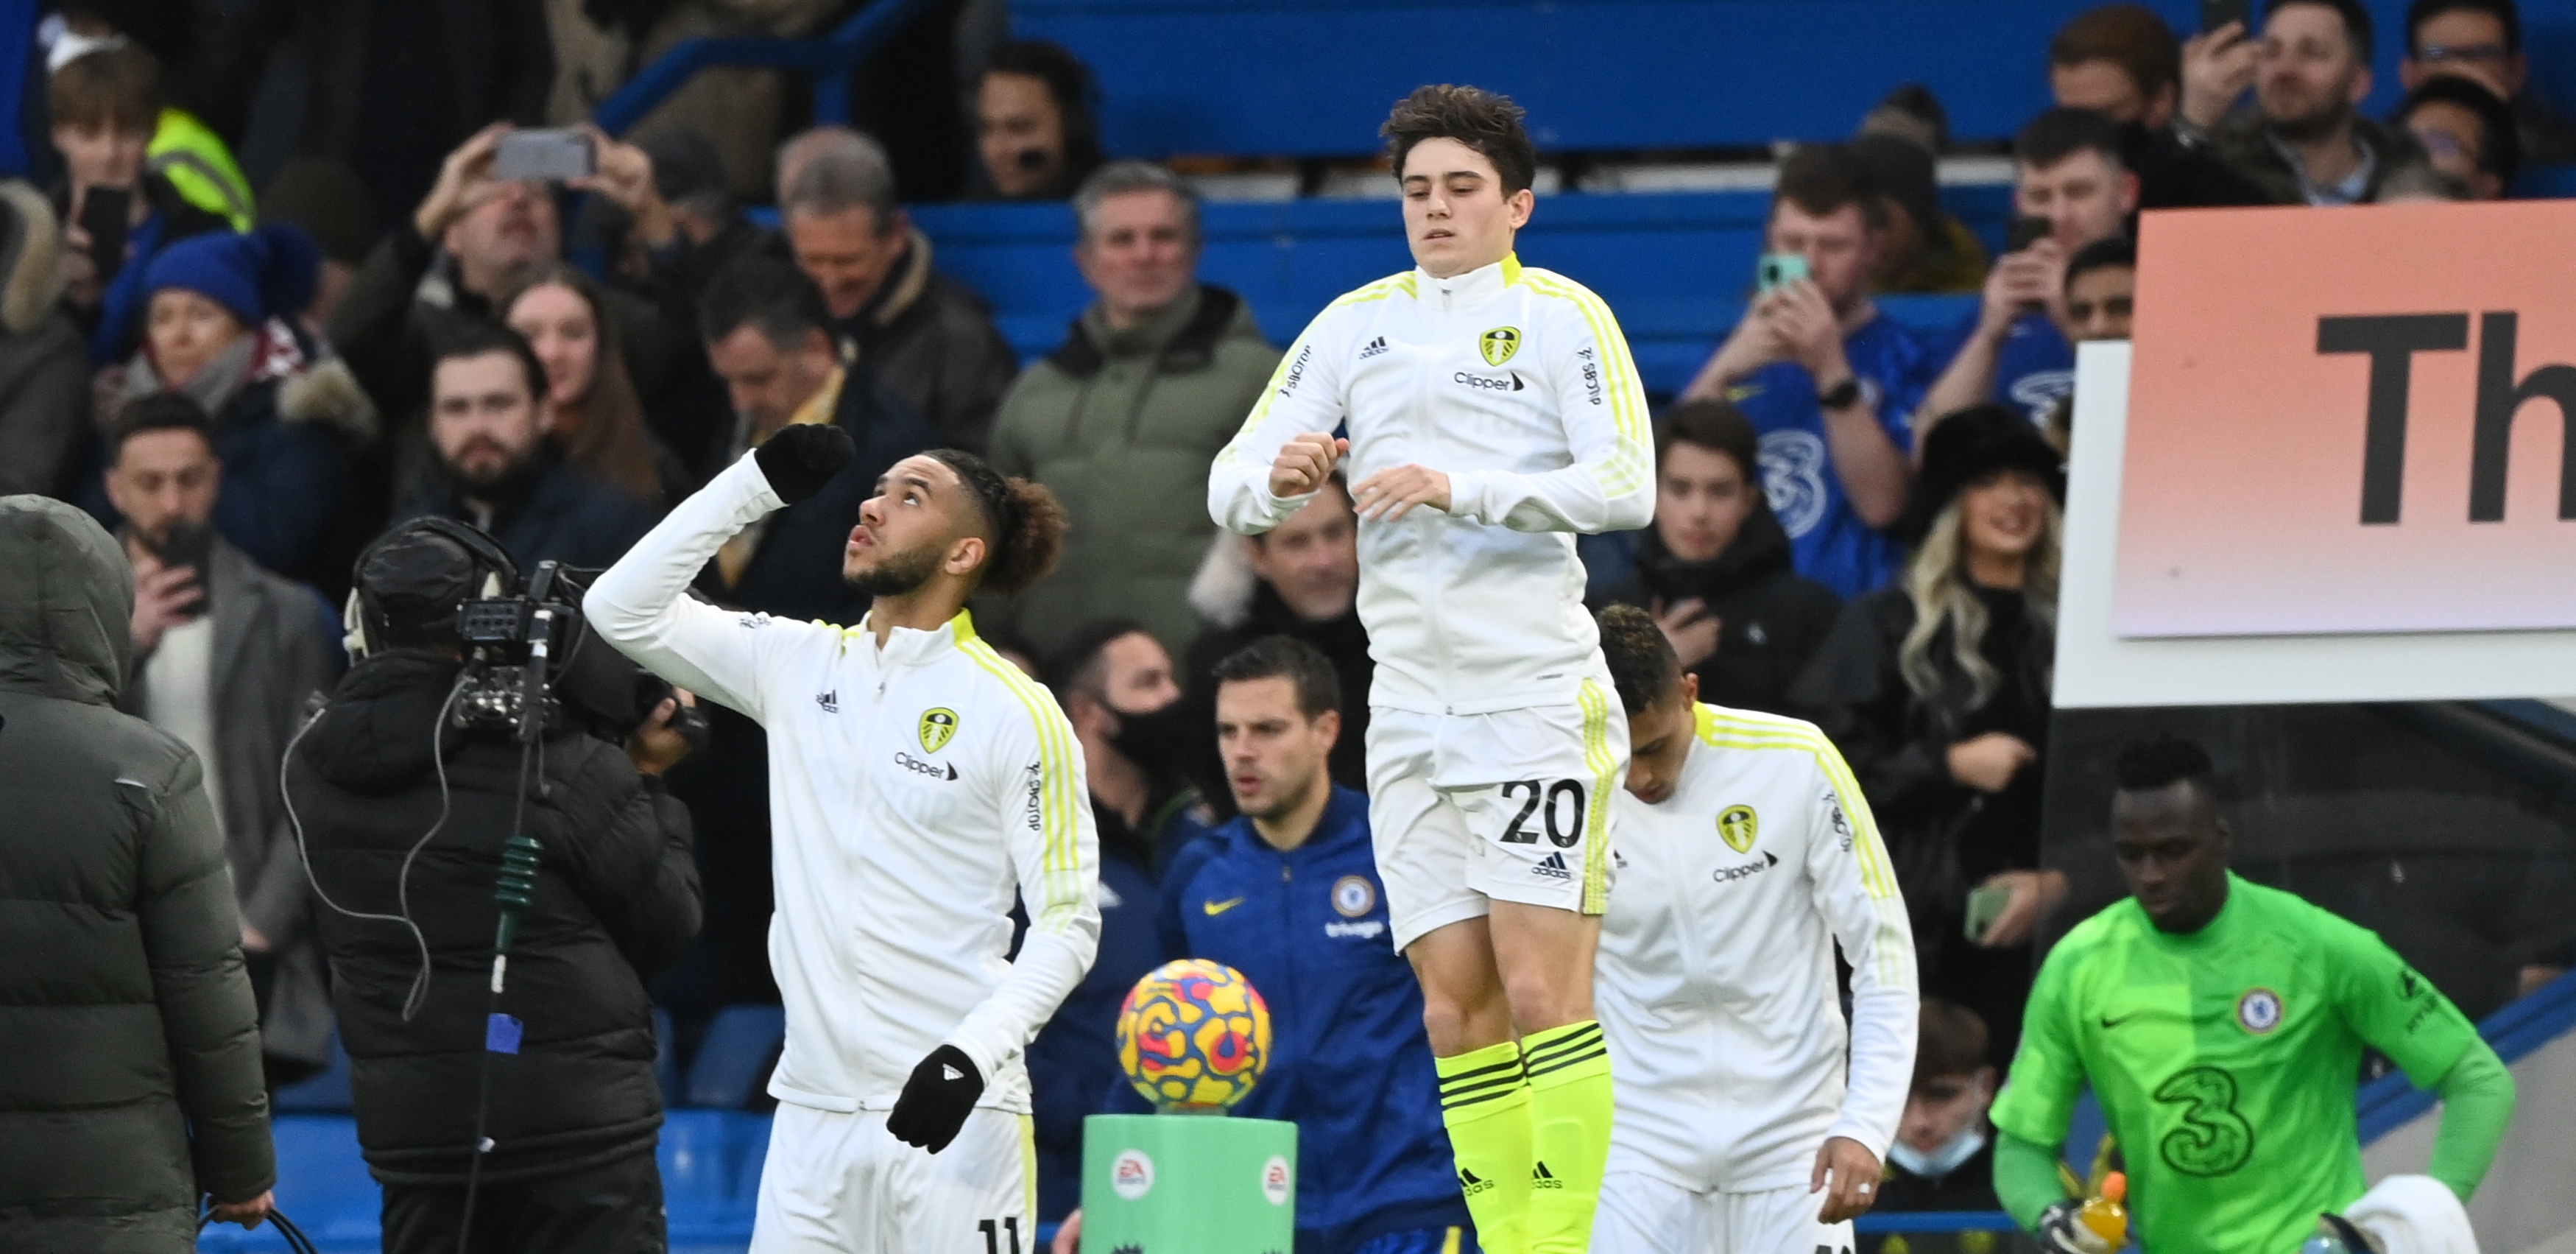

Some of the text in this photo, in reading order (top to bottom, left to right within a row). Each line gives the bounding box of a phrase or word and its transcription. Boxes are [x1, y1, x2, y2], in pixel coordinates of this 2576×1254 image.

[1454, 371, 1511, 392] Clipper
[894, 752, 945, 778] Clipper
[1499, 778, 1585, 848] 20
[1531, 866, 1571, 880] adidas
[1712, 861, 1764, 882] Clipper
[2153, 1066, 2254, 1177] 3
[978, 1216, 1020, 1254] 11
